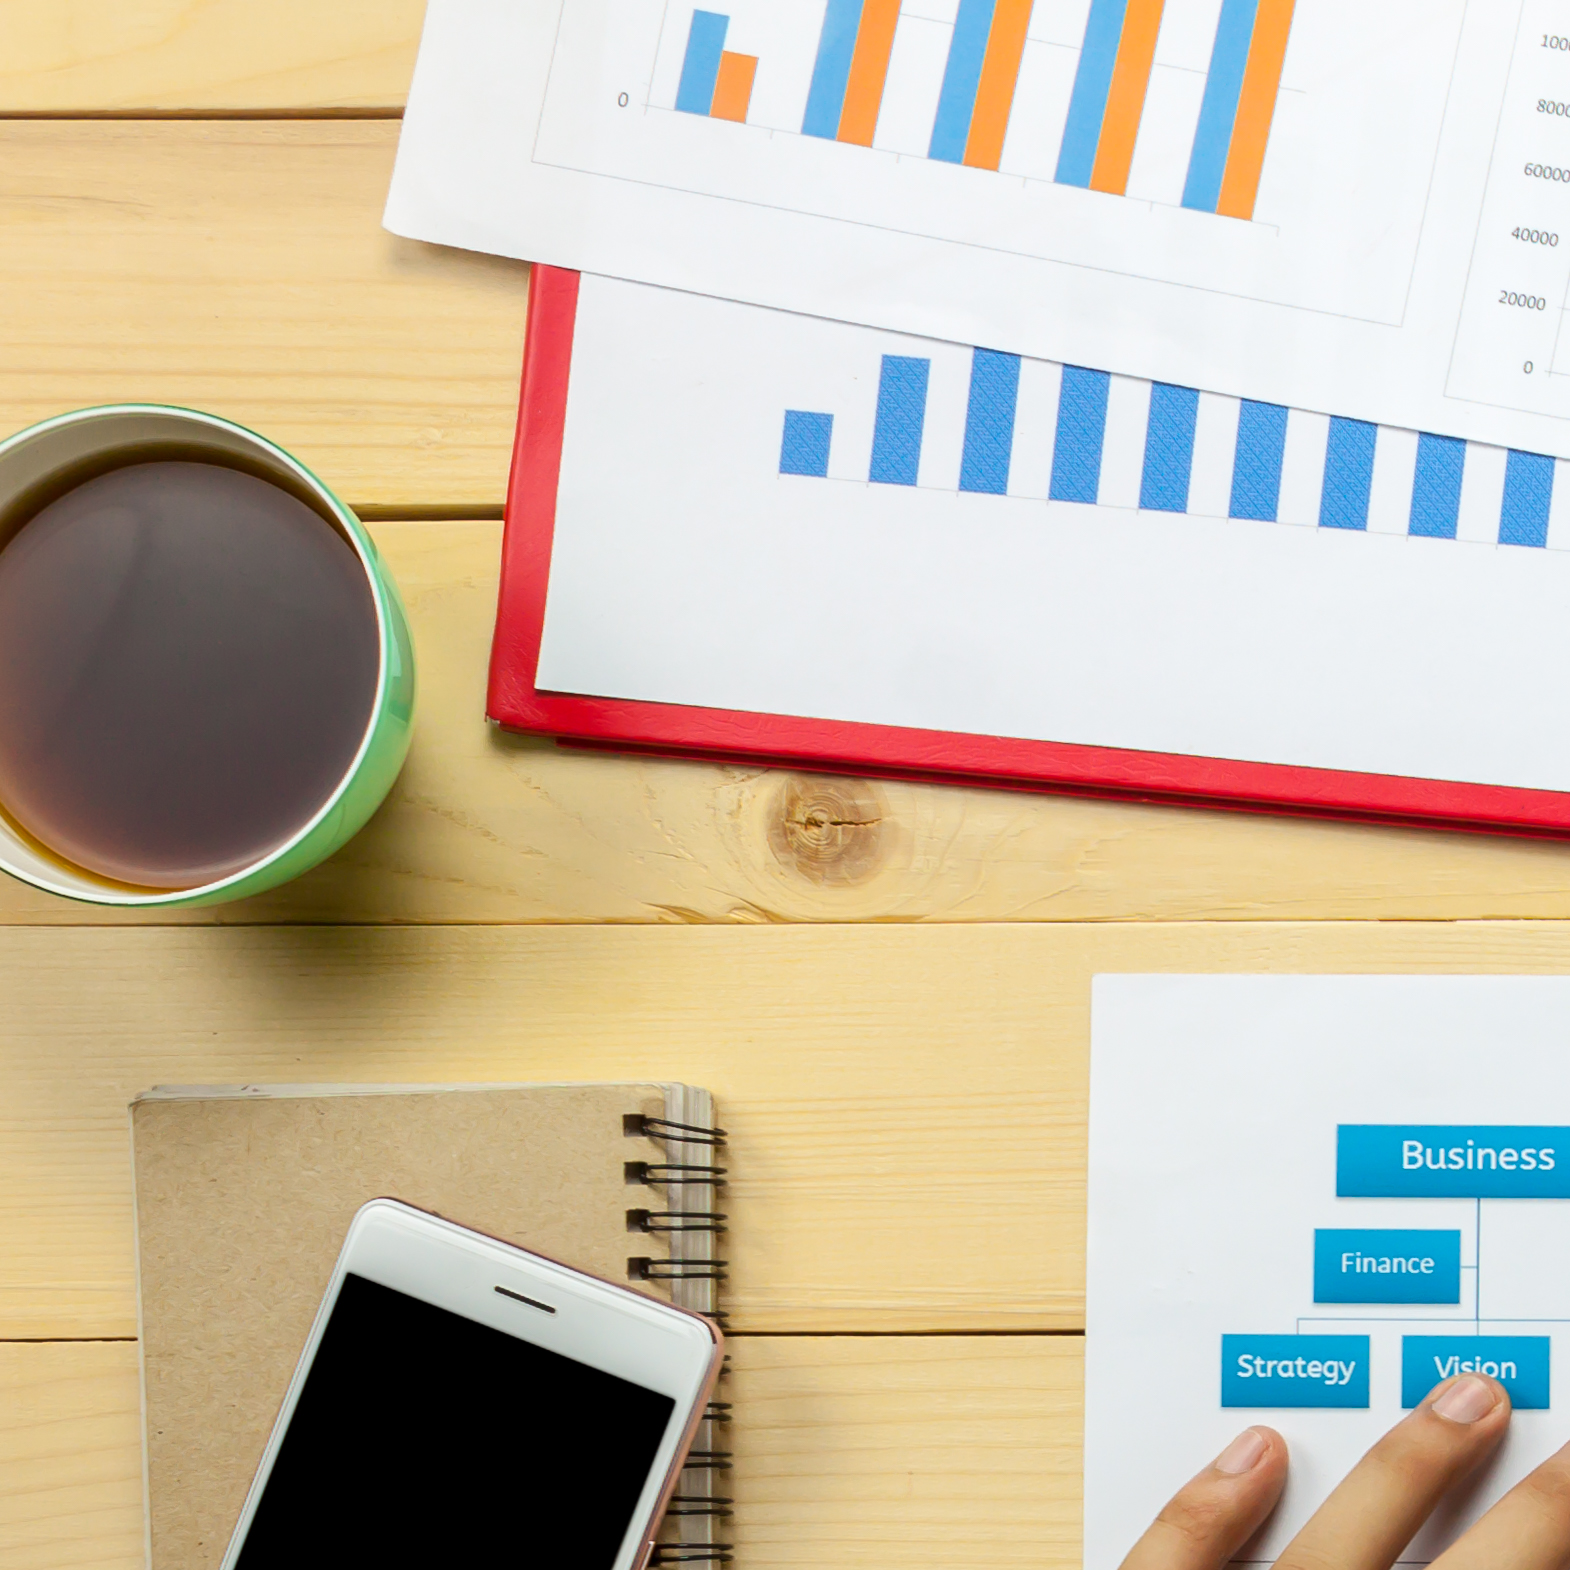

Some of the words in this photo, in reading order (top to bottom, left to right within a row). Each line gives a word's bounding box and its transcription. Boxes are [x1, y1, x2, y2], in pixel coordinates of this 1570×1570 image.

[617, 91, 629, 108] 0
[1511, 226, 1559, 248] 40000
[1498, 289, 1547, 311] 20000
[1522, 360, 1534, 375] 0
[1402, 1139, 1556, 1171] Business
[1341, 1251, 1435, 1274] Finance
[1236, 1353, 1356, 1386] Strategy
